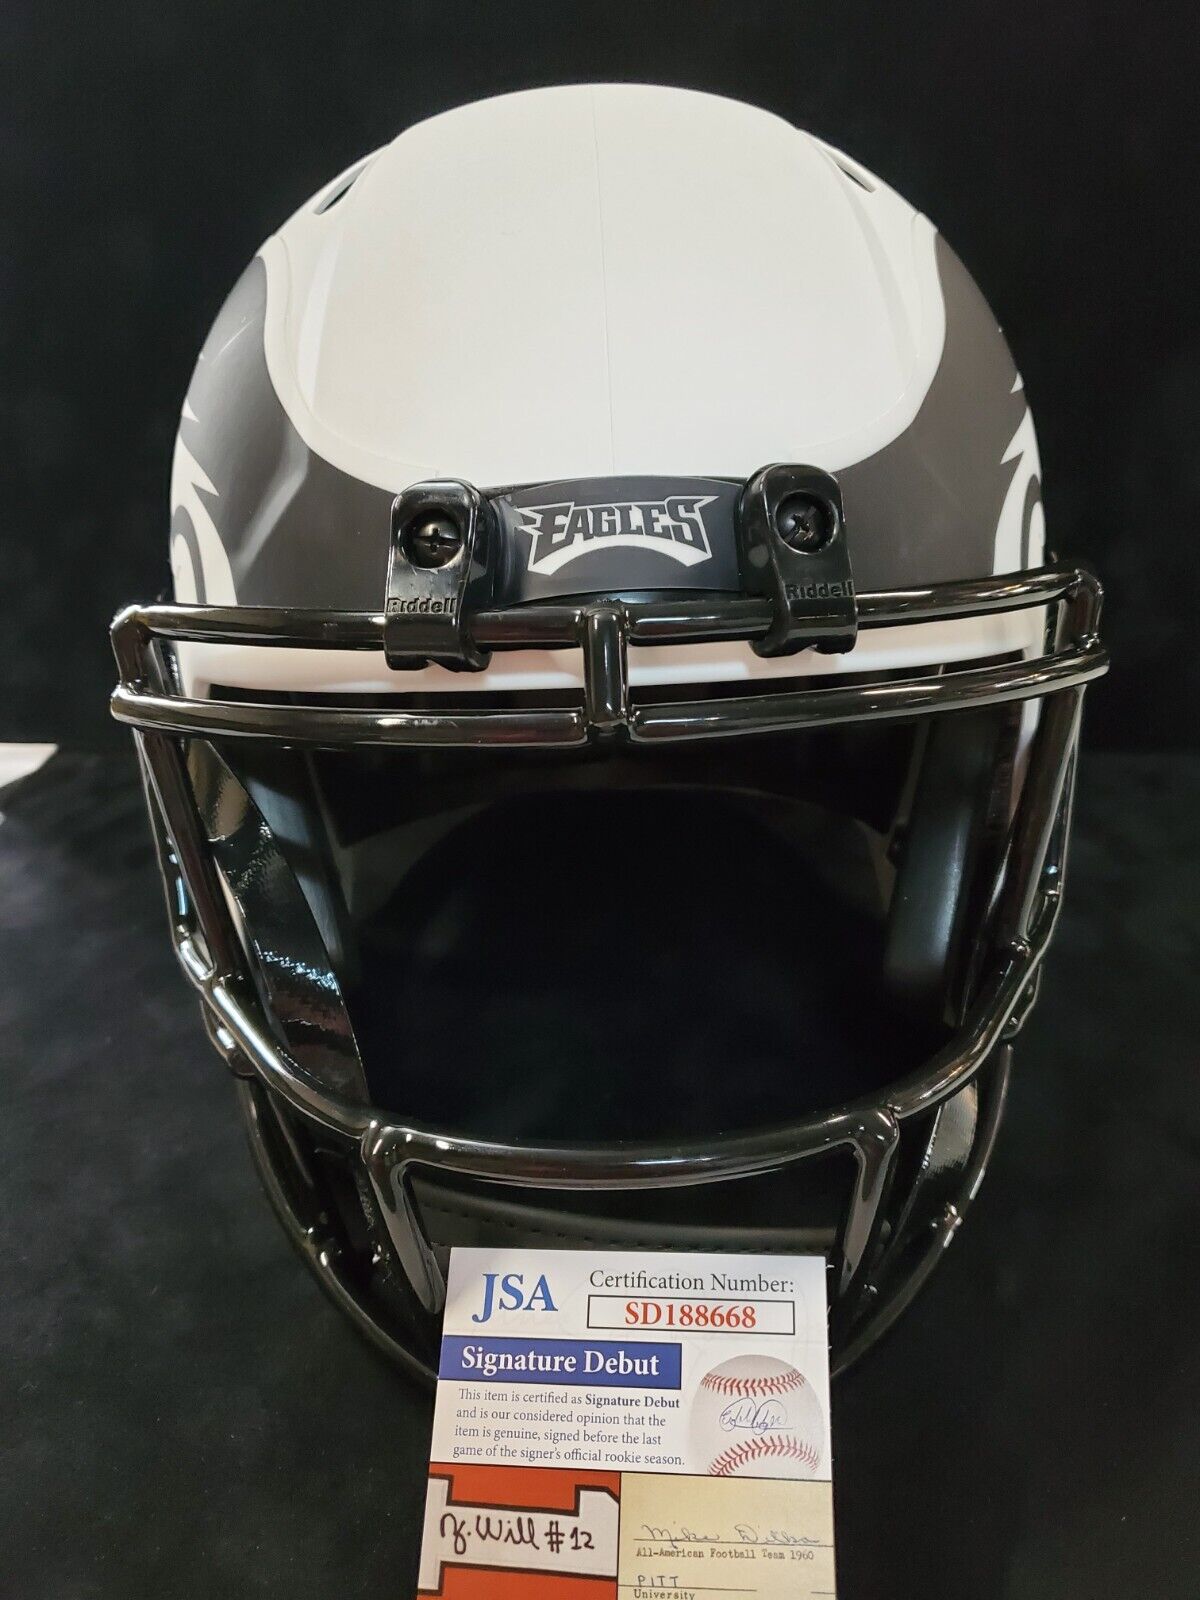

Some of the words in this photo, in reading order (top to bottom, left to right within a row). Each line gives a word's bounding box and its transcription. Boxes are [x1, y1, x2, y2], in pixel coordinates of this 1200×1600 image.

[518, 495, 717, 567] EAGLES
[787, 583, 855, 599] Riddell
[387, 598, 458, 613] Riddell
[590, 1271, 704, 1290] Certification
[711, 1274, 794, 1293] Number:
[472, 1273, 558, 1323] JSA
[625, 1302, 756, 1328] SD188668
[462, 1346, 576, 1374] Signature
[583, 1351, 659, 1375] Debut
[459, 1388, 480, 1401] This
[484, 1390, 508, 1401] item
[511, 1392, 520, 1403] is
[523, 1391, 568, 1405] certified
[585, 1394, 640, 1409] Signature
[644, 1396, 680, 1409] Debut
[457, 1407, 476, 1418] and
[480, 1409, 488, 1419] is
[491, 1412, 510, 1420] our
[514, 1409, 573, 1423] considered
[577, 1413, 620, 1427] opinion
[623, 1413, 645, 1425] that
[648, 1414, 666, 1426] the
[455, 1425, 479, 1437] item
[482, 1427, 491, 1438] is
[495, 1430, 540, 1444] genuine,
[544, 1429, 580, 1444] signed
[583, 1430, 618, 1444] before
[622, 1431, 640, 1444] the
[643, 1433, 661, 1445] last
[453, 1447, 482, 1460] game
[485, 1445, 497, 1456] of
[499, 1445, 517, 1457] the
[520, 1446, 561, 1463] signer's
[564, 1447, 602, 1460] official
[605, 1449, 642, 1462] rookie
[645, 1454, 685, 1465] season.
[545, 1522, 595, 1553] #12
[636, 1548, 705, 1558] All-American
[710, 1549, 756, 1559] Football
[762, 1550, 785, 1559] Team
[790, 1550, 814, 1560] 1960
[638, 1575, 679, 1587] PITT
[634, 1589, 695, 1600] University
